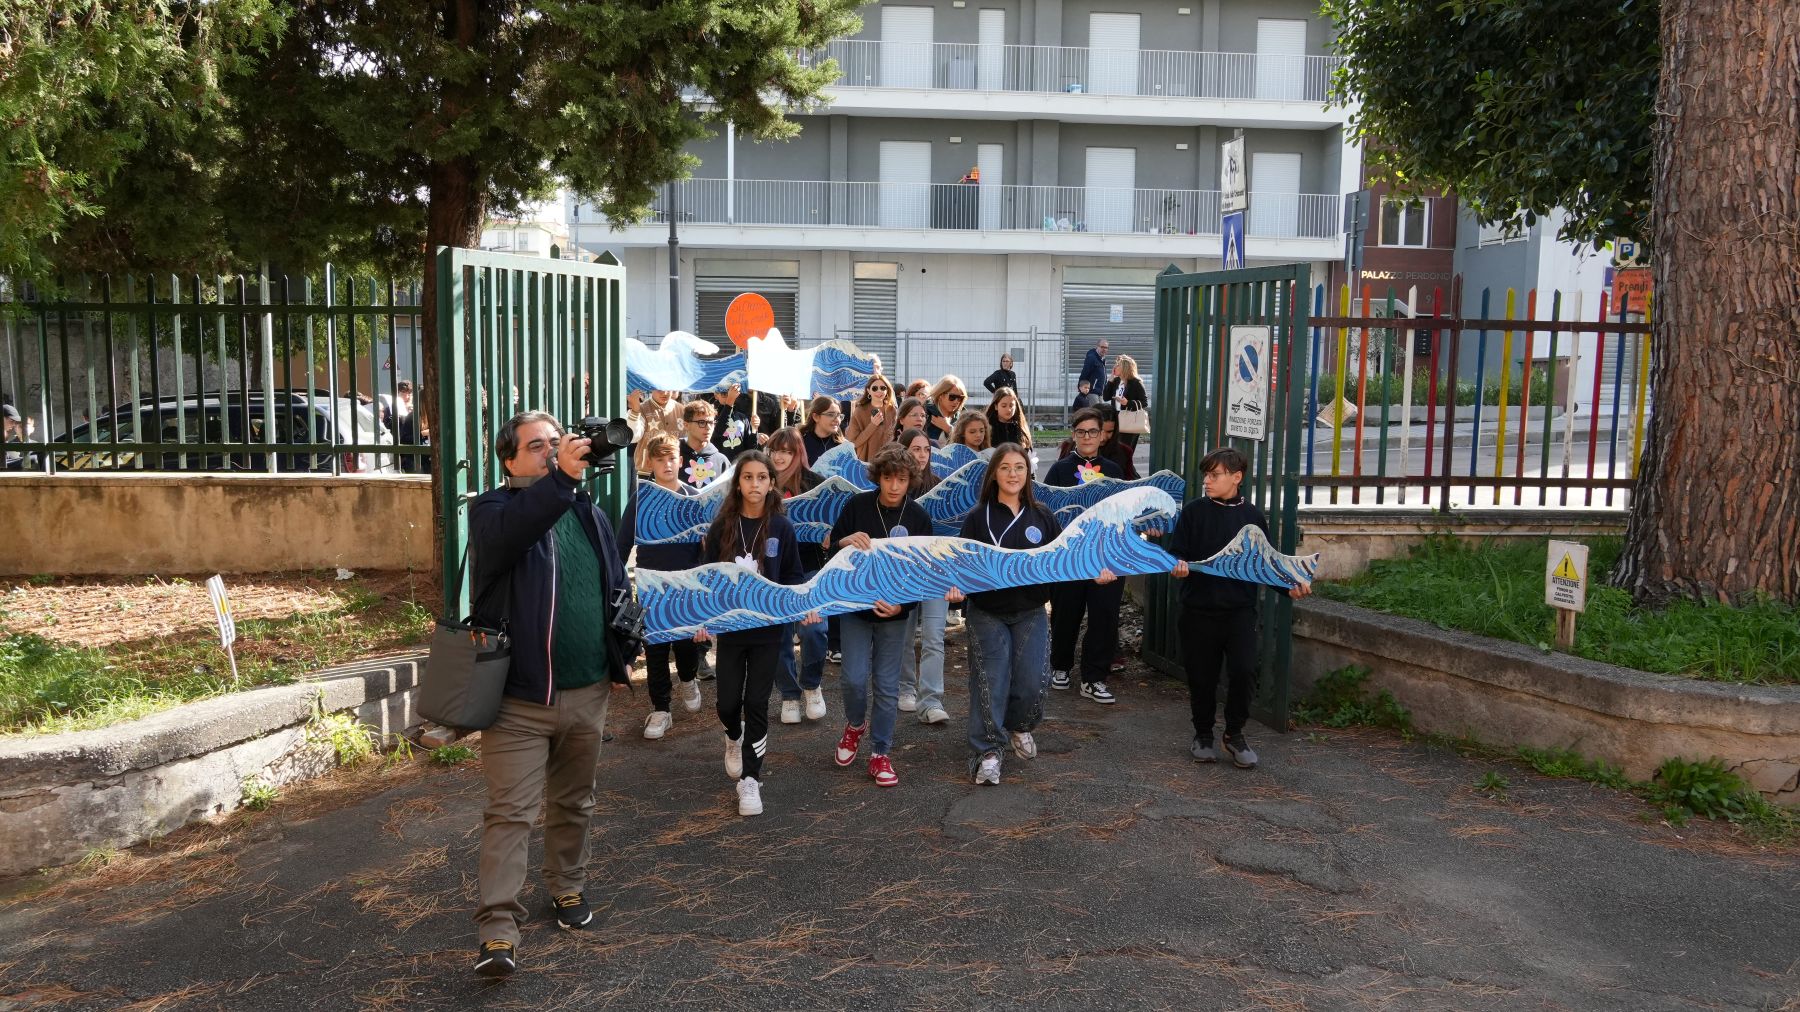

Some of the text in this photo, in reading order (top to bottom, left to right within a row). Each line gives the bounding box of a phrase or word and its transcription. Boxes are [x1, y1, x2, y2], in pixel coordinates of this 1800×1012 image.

[1623, 245, 1632, 255] P
[1361, 270, 1403, 280] PALAZZO
[1552, 577, 1579, 588] ATTENZIONE
